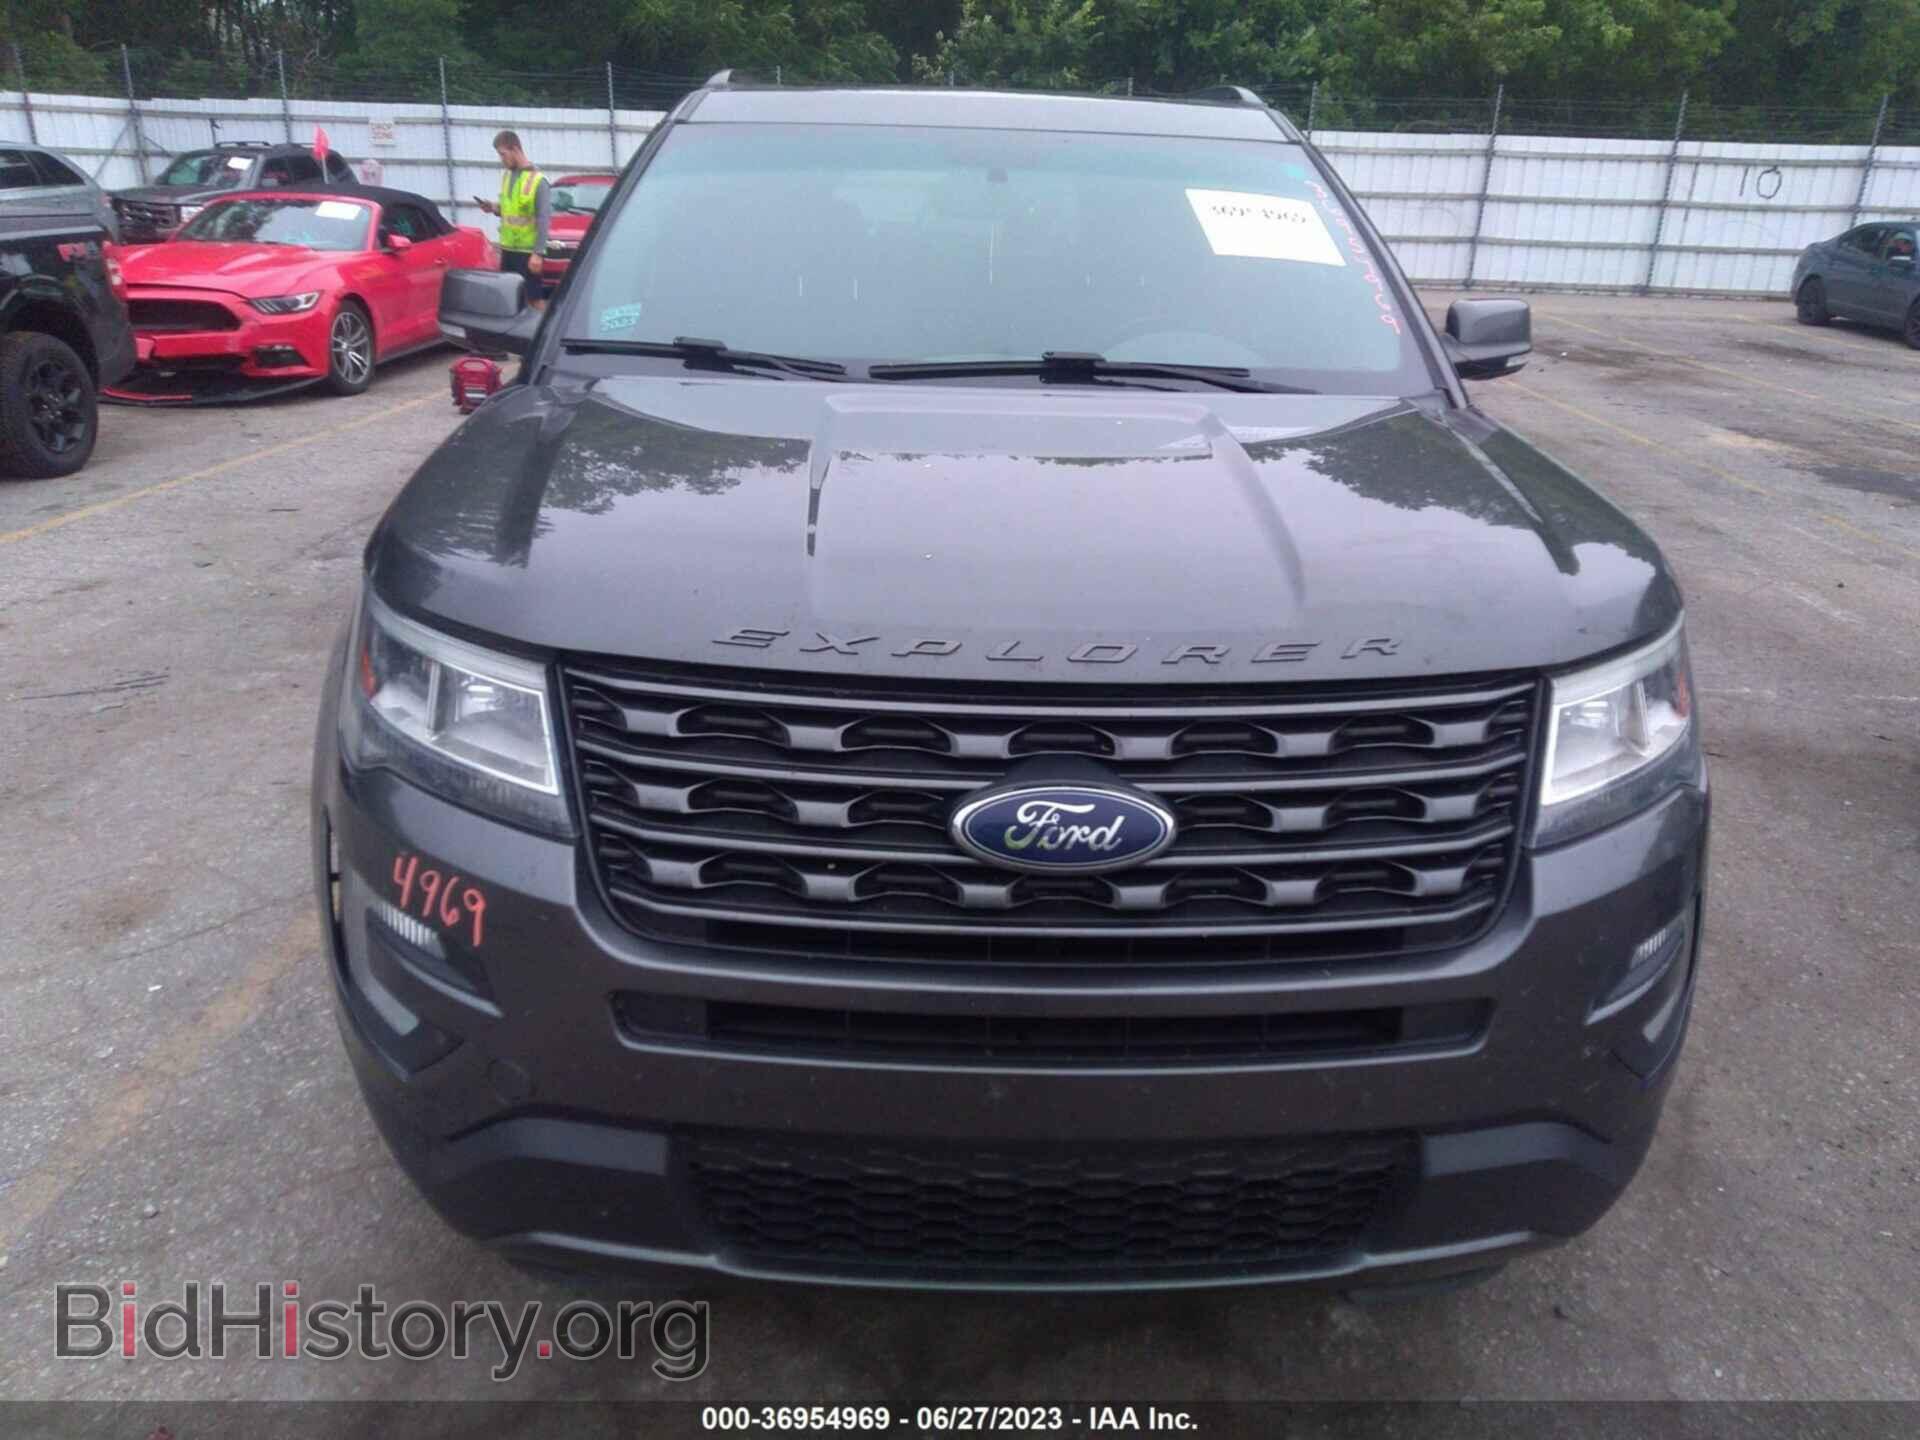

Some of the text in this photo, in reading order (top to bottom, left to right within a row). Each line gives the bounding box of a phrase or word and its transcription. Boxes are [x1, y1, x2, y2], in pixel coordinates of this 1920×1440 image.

[1739, 165, 1782, 200] 10
[712, 628, 1401, 664] EXPLORER
[1004, 800, 1125, 851] Ford
[392, 856, 487, 947] 4969
